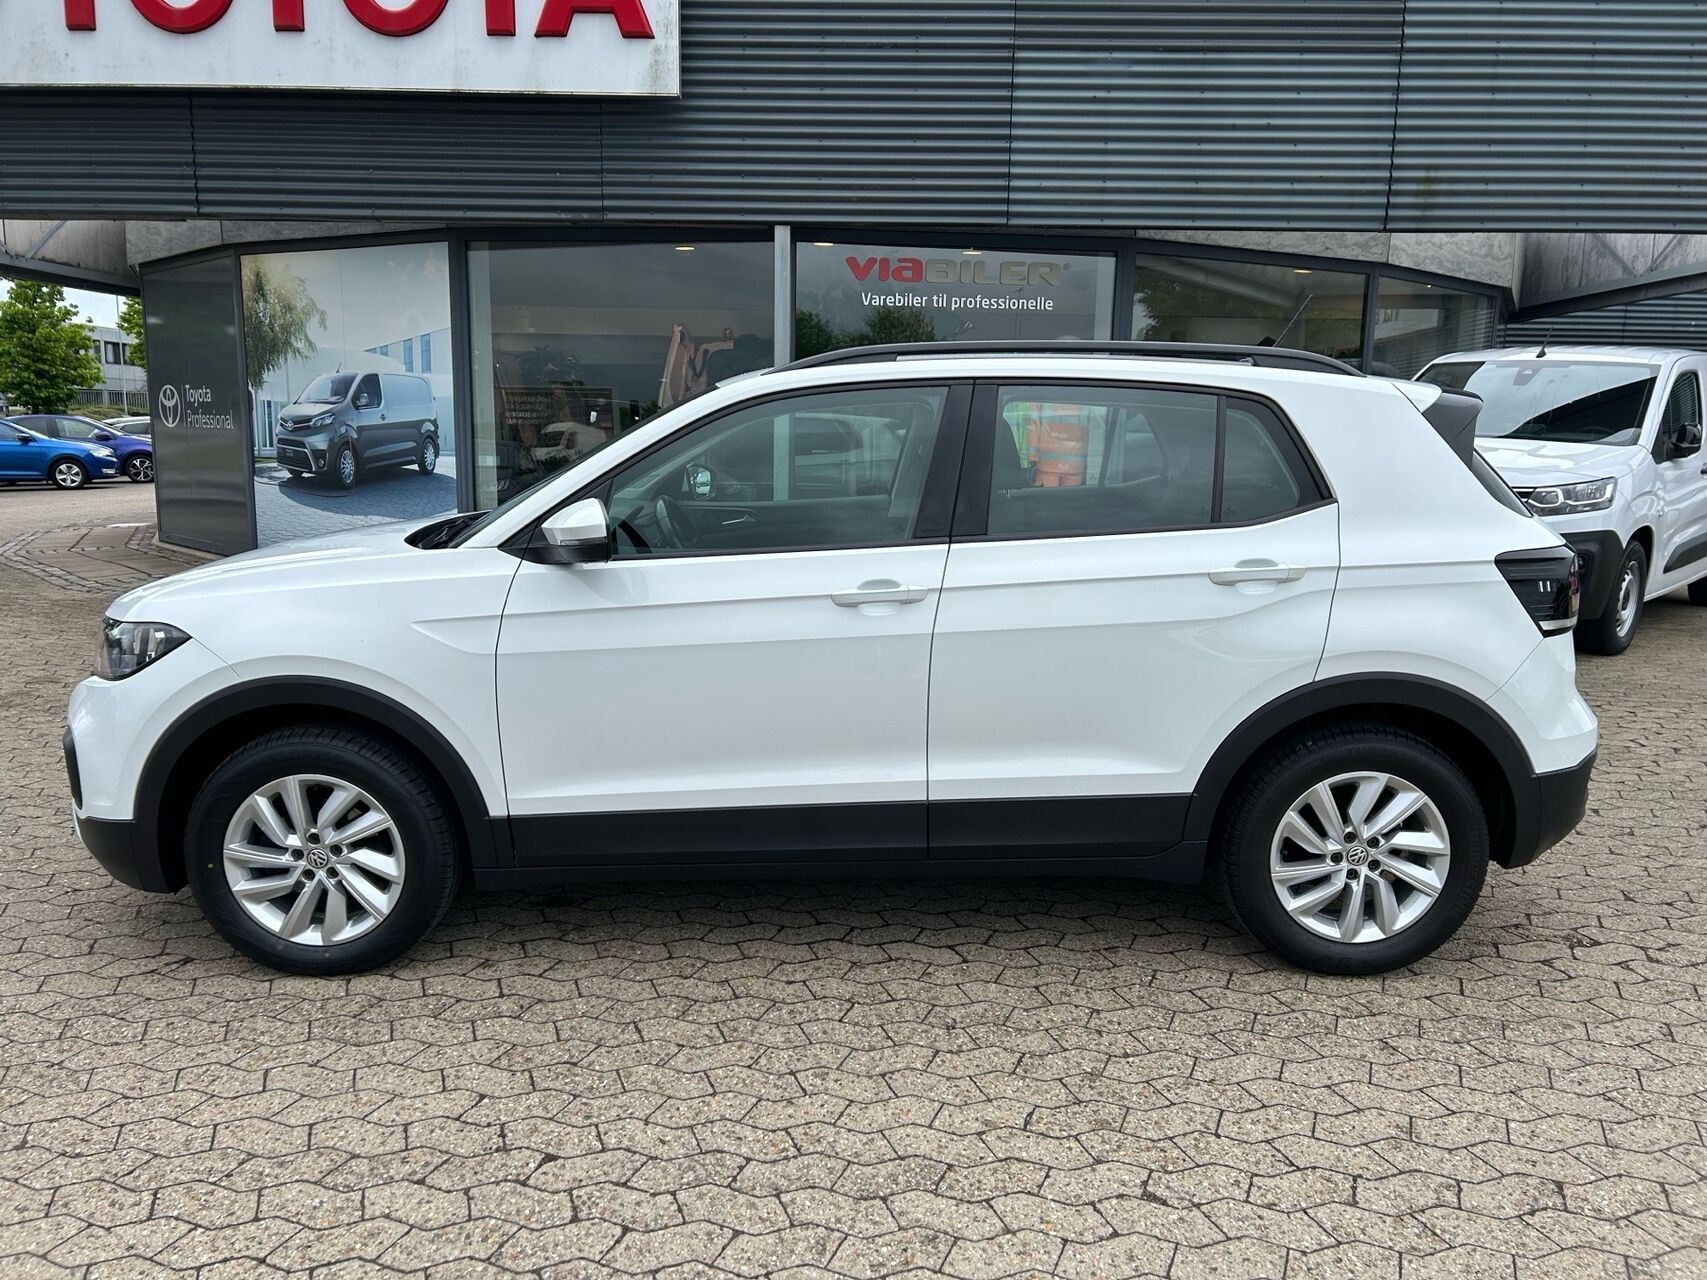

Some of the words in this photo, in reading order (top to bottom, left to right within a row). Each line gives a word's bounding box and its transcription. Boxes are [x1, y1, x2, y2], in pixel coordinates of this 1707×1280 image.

[861, 292, 928, 308] Varebiler
[932, 294, 947, 308] til
[950, 295, 1054, 311] professionelle
[185, 384, 211, 407] Toyota
[187, 409, 233, 429] Professional
